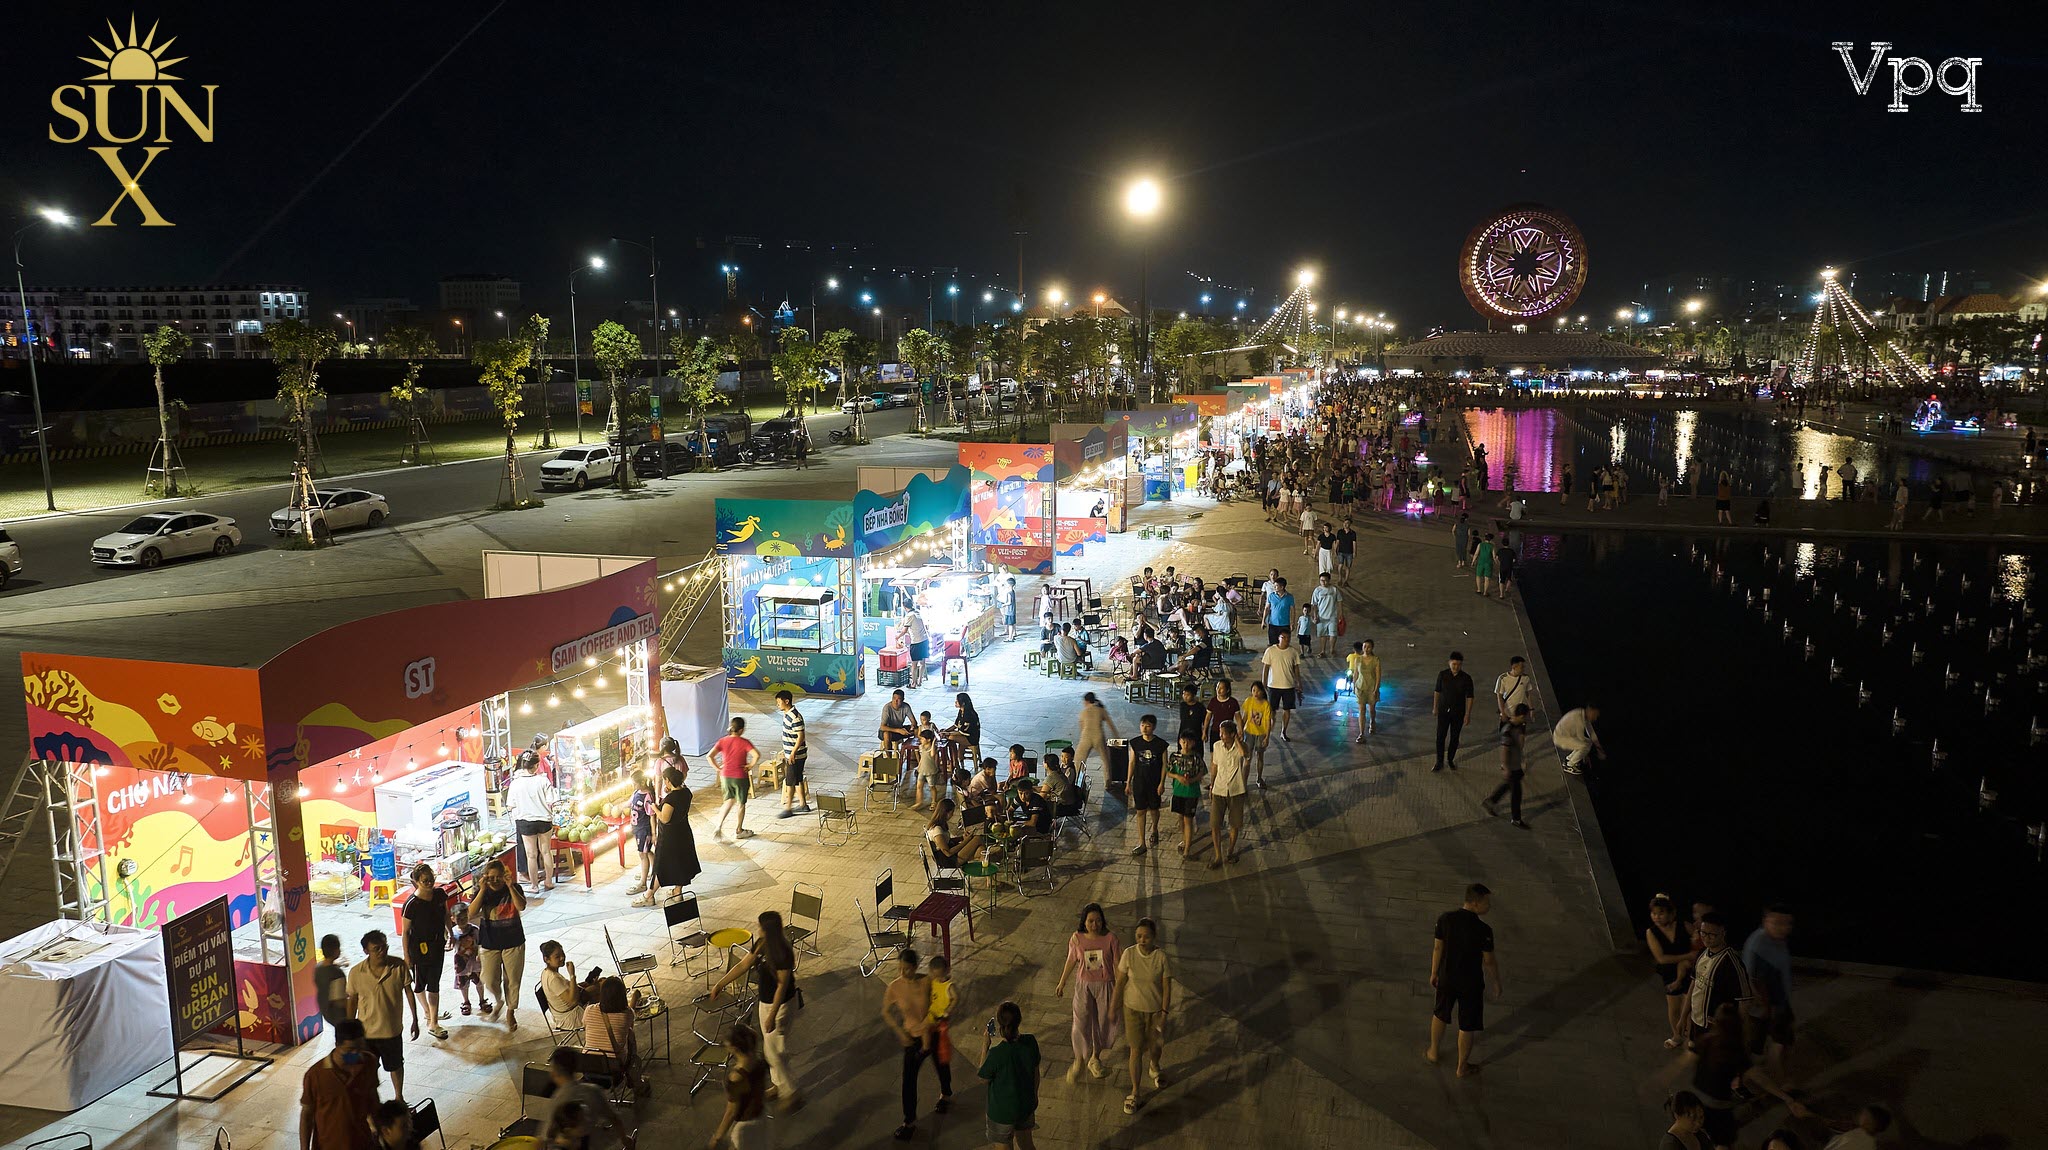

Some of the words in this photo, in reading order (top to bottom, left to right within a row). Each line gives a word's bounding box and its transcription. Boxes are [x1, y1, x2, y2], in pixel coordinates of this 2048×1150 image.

[554, 645, 577, 669] SAM
[580, 632, 615, 658] COFFEE
[617, 623, 637, 644] AND
[638, 617, 655, 634] TEA
[409, 662, 432, 692] ST
[174, 945, 197, 969] ĐIỂM
[198, 941, 209, 957] TƯ
[189, 960, 202, 979] DỰ
[204, 954, 216, 971] ÁN
[190, 972, 218, 998] SUN
[182, 982, 229, 1020] URBAN
[191, 1002, 222, 1031] CITY
